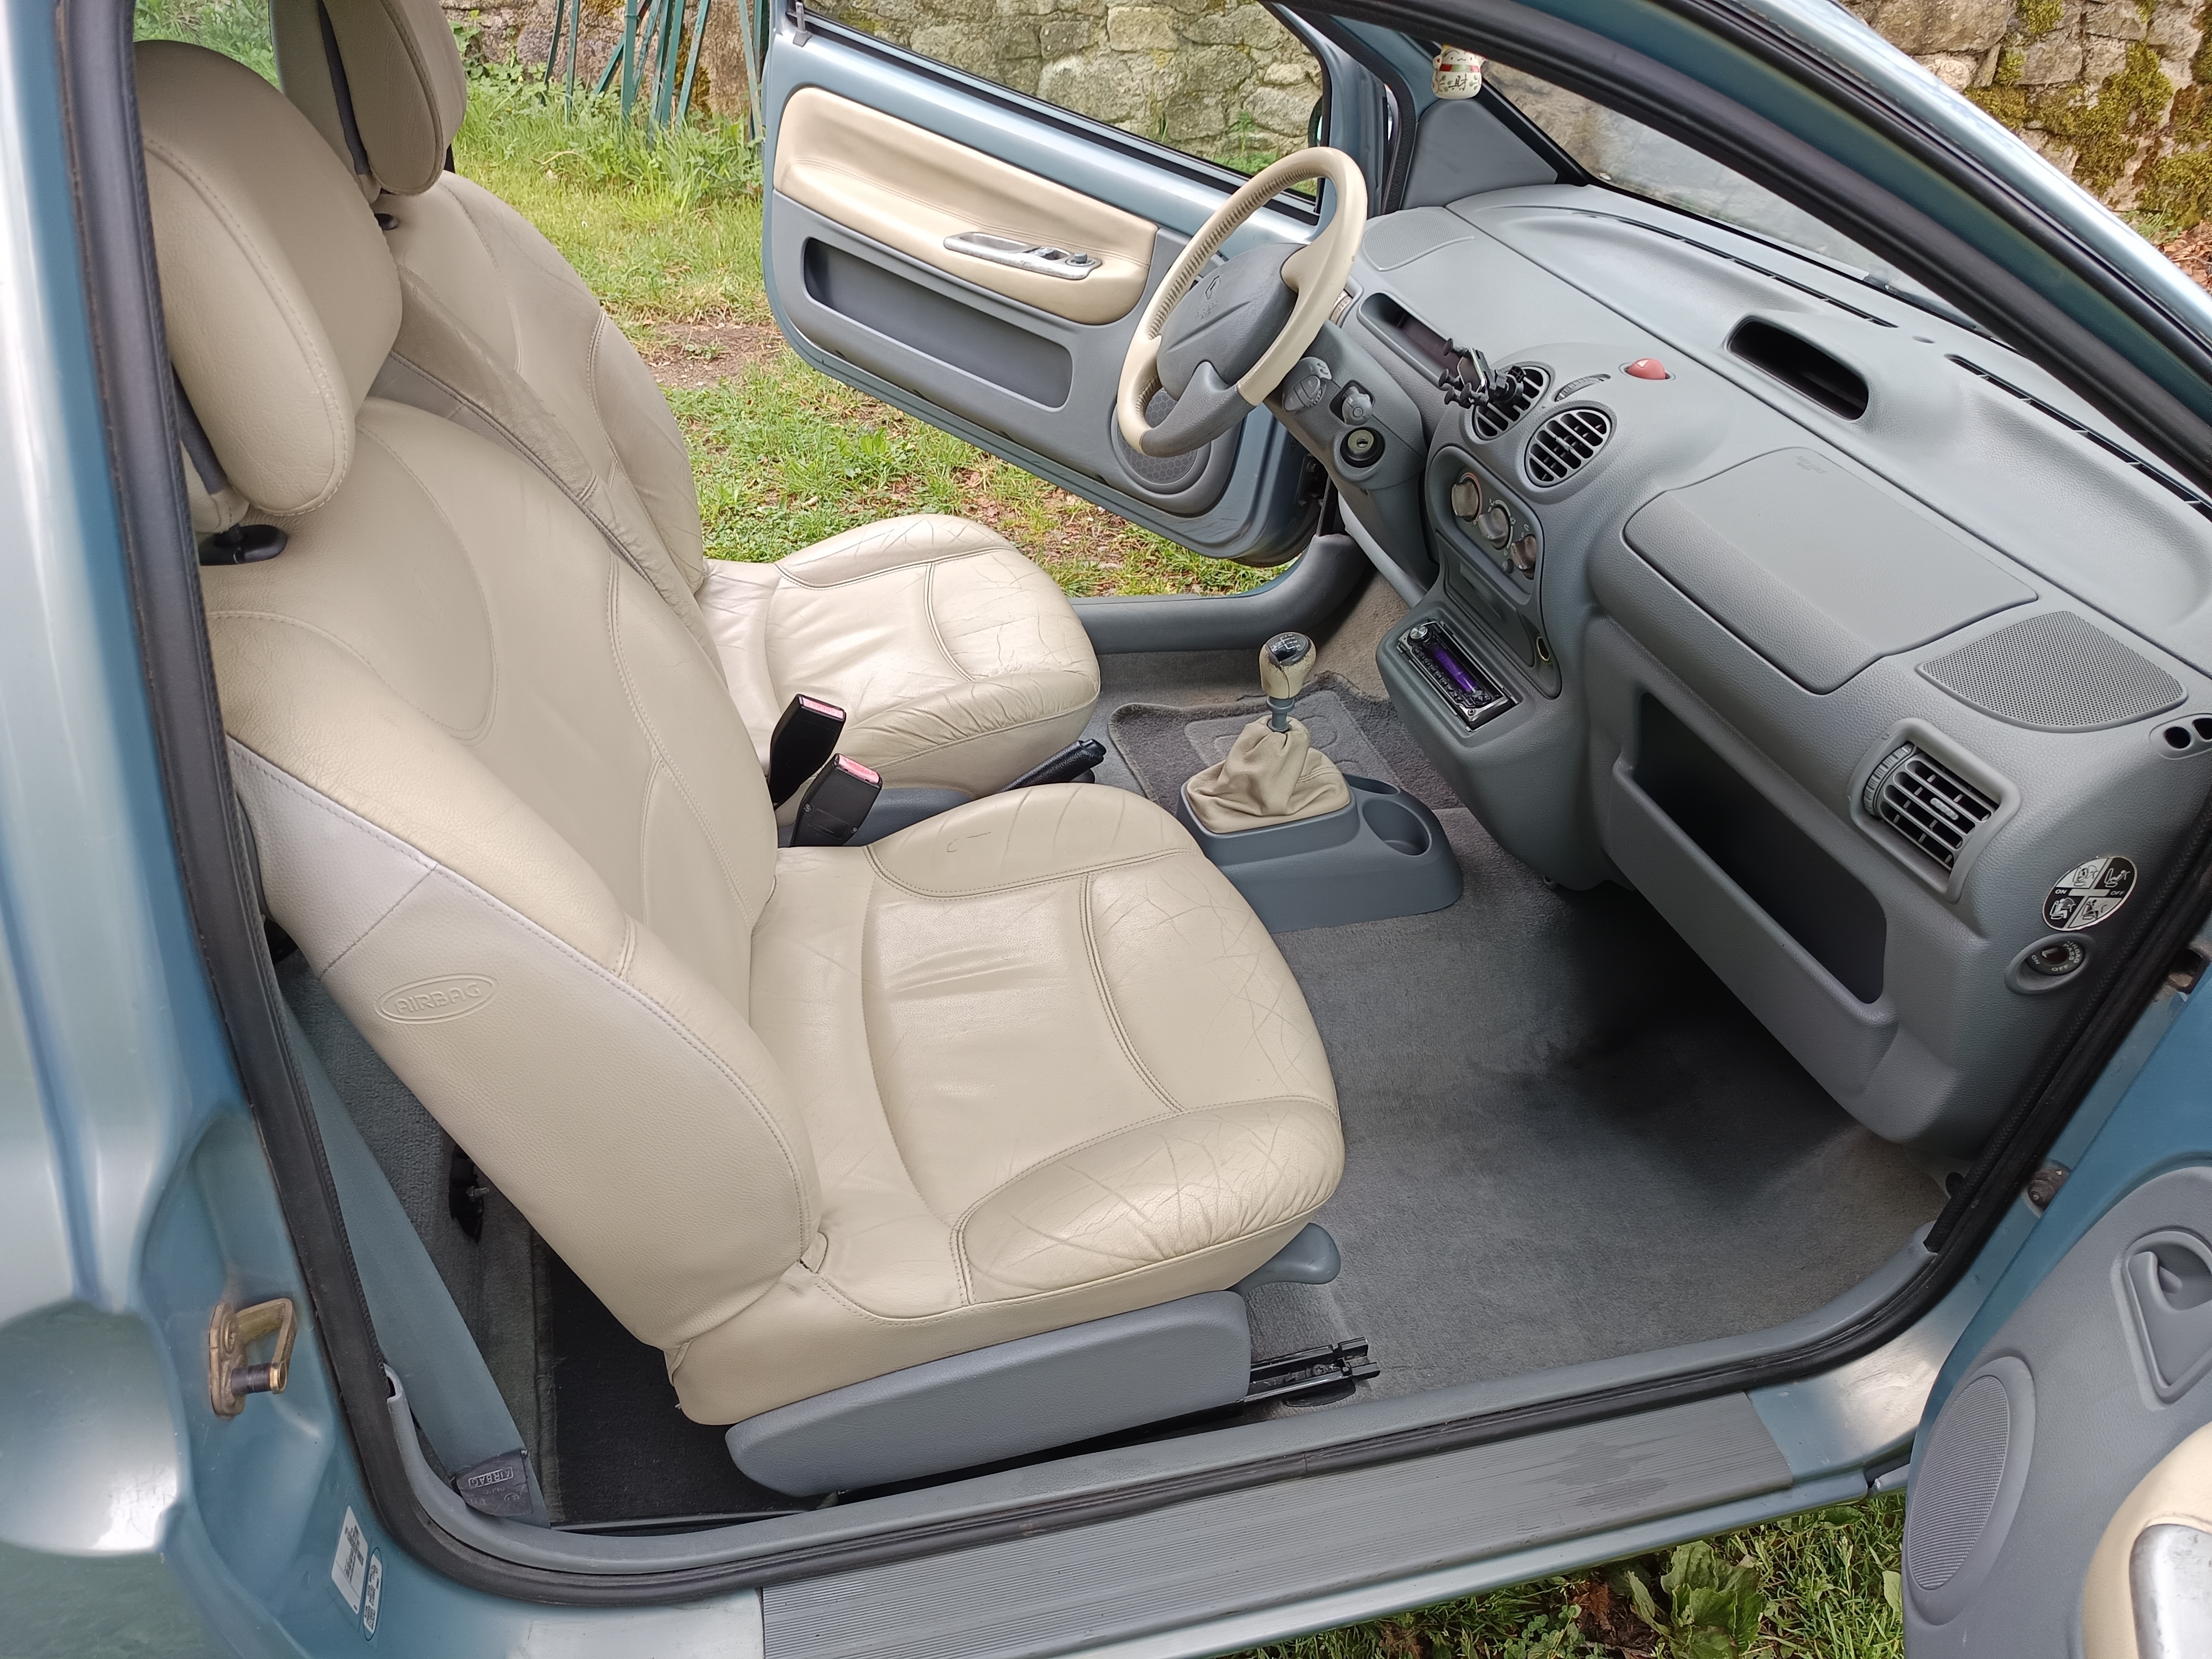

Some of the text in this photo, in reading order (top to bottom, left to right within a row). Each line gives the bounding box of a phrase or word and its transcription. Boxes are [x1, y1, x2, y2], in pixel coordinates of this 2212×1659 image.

[2031, 954, 2041, 964] ON
[395, 982, 482, 1014] AIRBAG
[471, 1469, 510, 1486] AIRBAG
